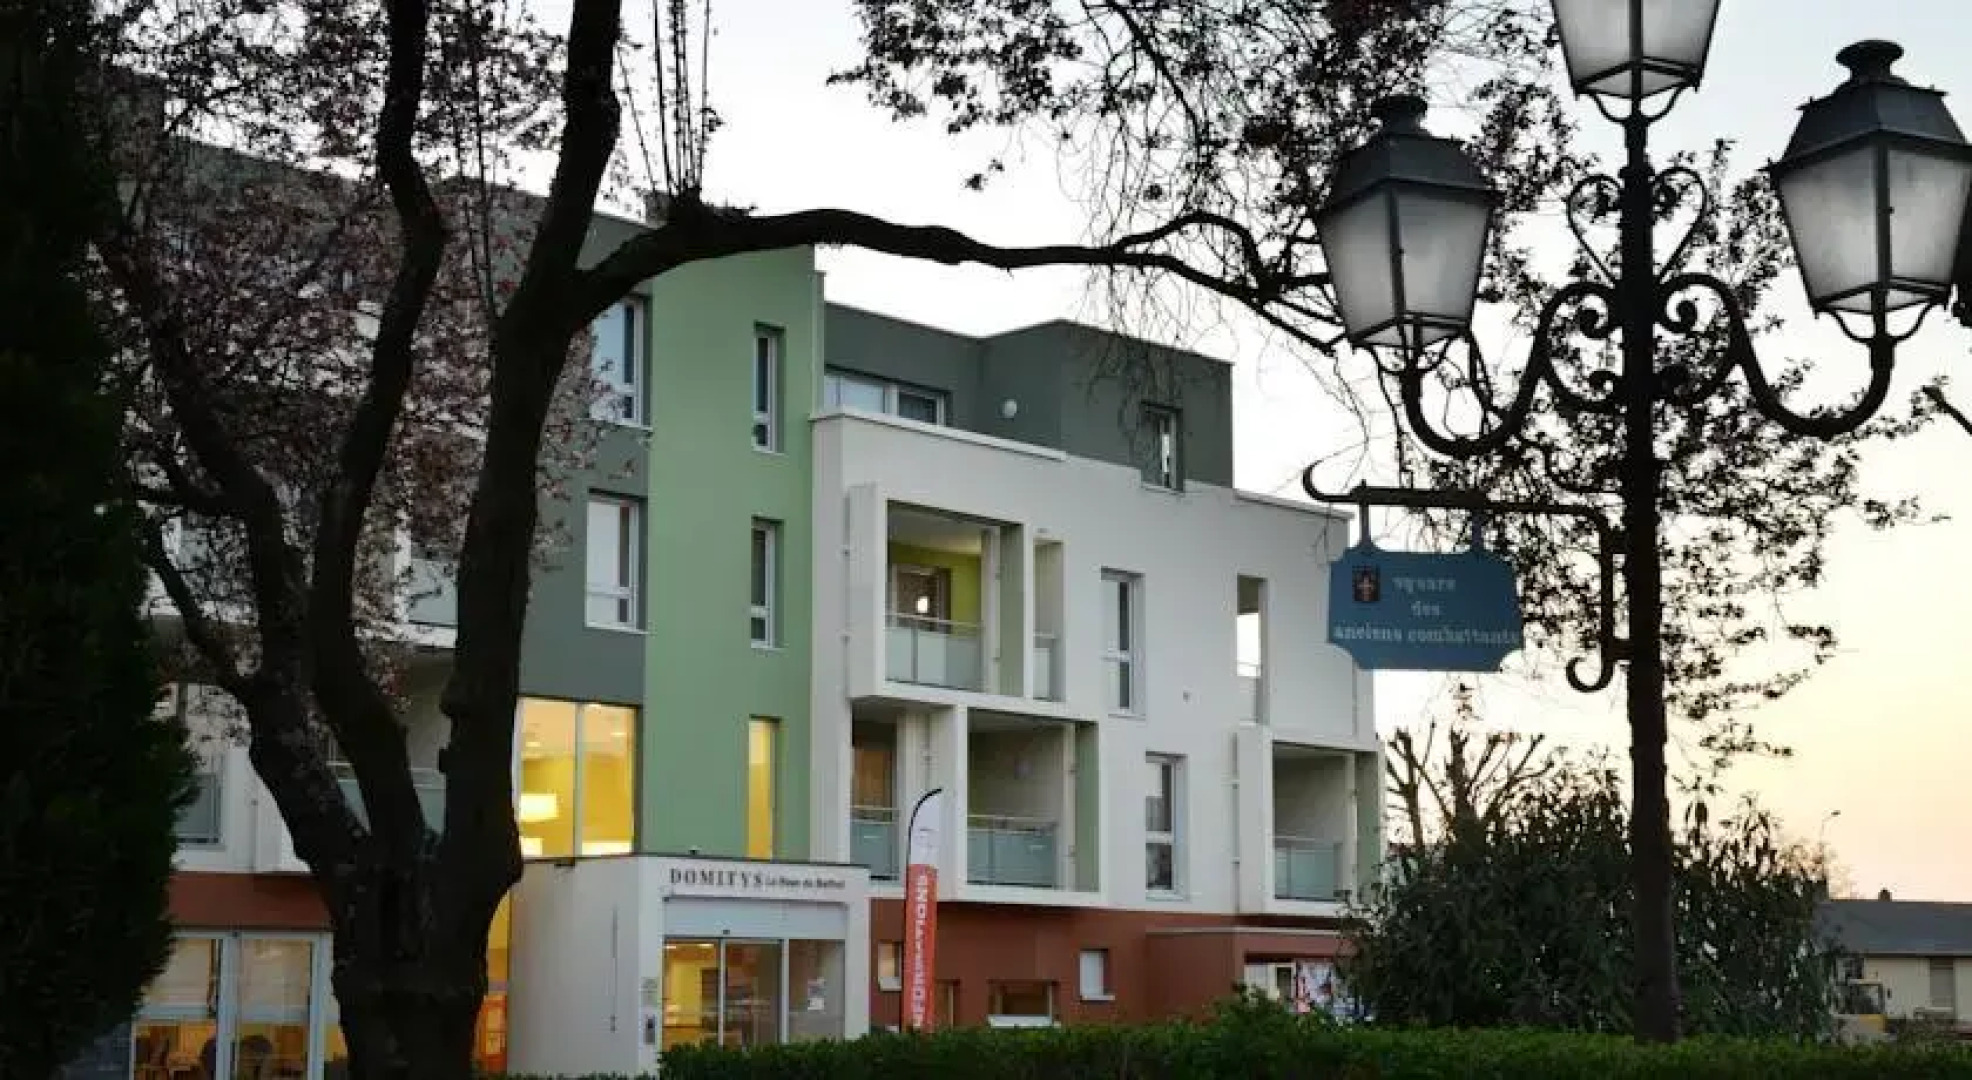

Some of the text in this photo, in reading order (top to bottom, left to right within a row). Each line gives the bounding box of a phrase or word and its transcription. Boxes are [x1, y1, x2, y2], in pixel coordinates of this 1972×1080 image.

[1411, 601, 1440, 616] des
[1333, 622, 1402, 641] anciens
[670, 868, 763, 888] DOMITYS
